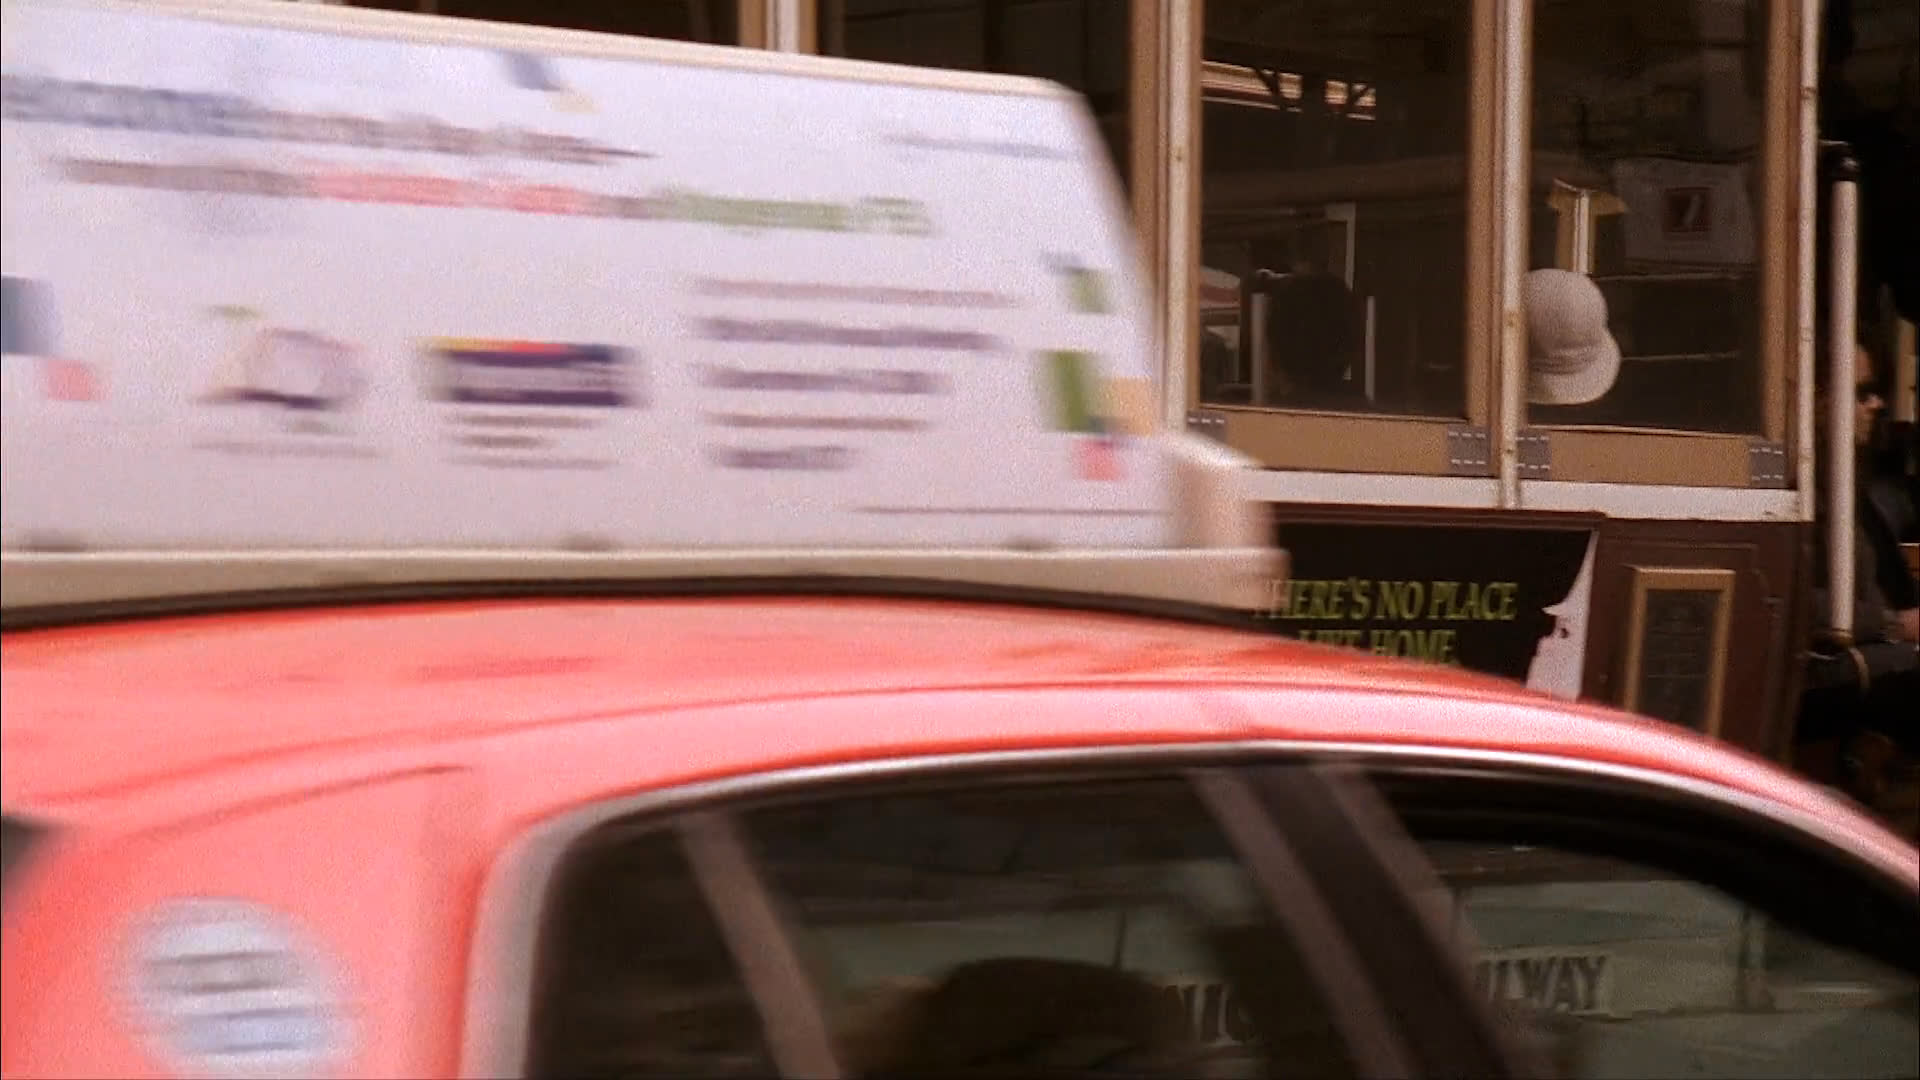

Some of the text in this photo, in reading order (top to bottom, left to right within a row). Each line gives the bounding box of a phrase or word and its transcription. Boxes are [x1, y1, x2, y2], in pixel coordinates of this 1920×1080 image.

[1266, 577, 1519, 621] HERE'S NO PLACE
